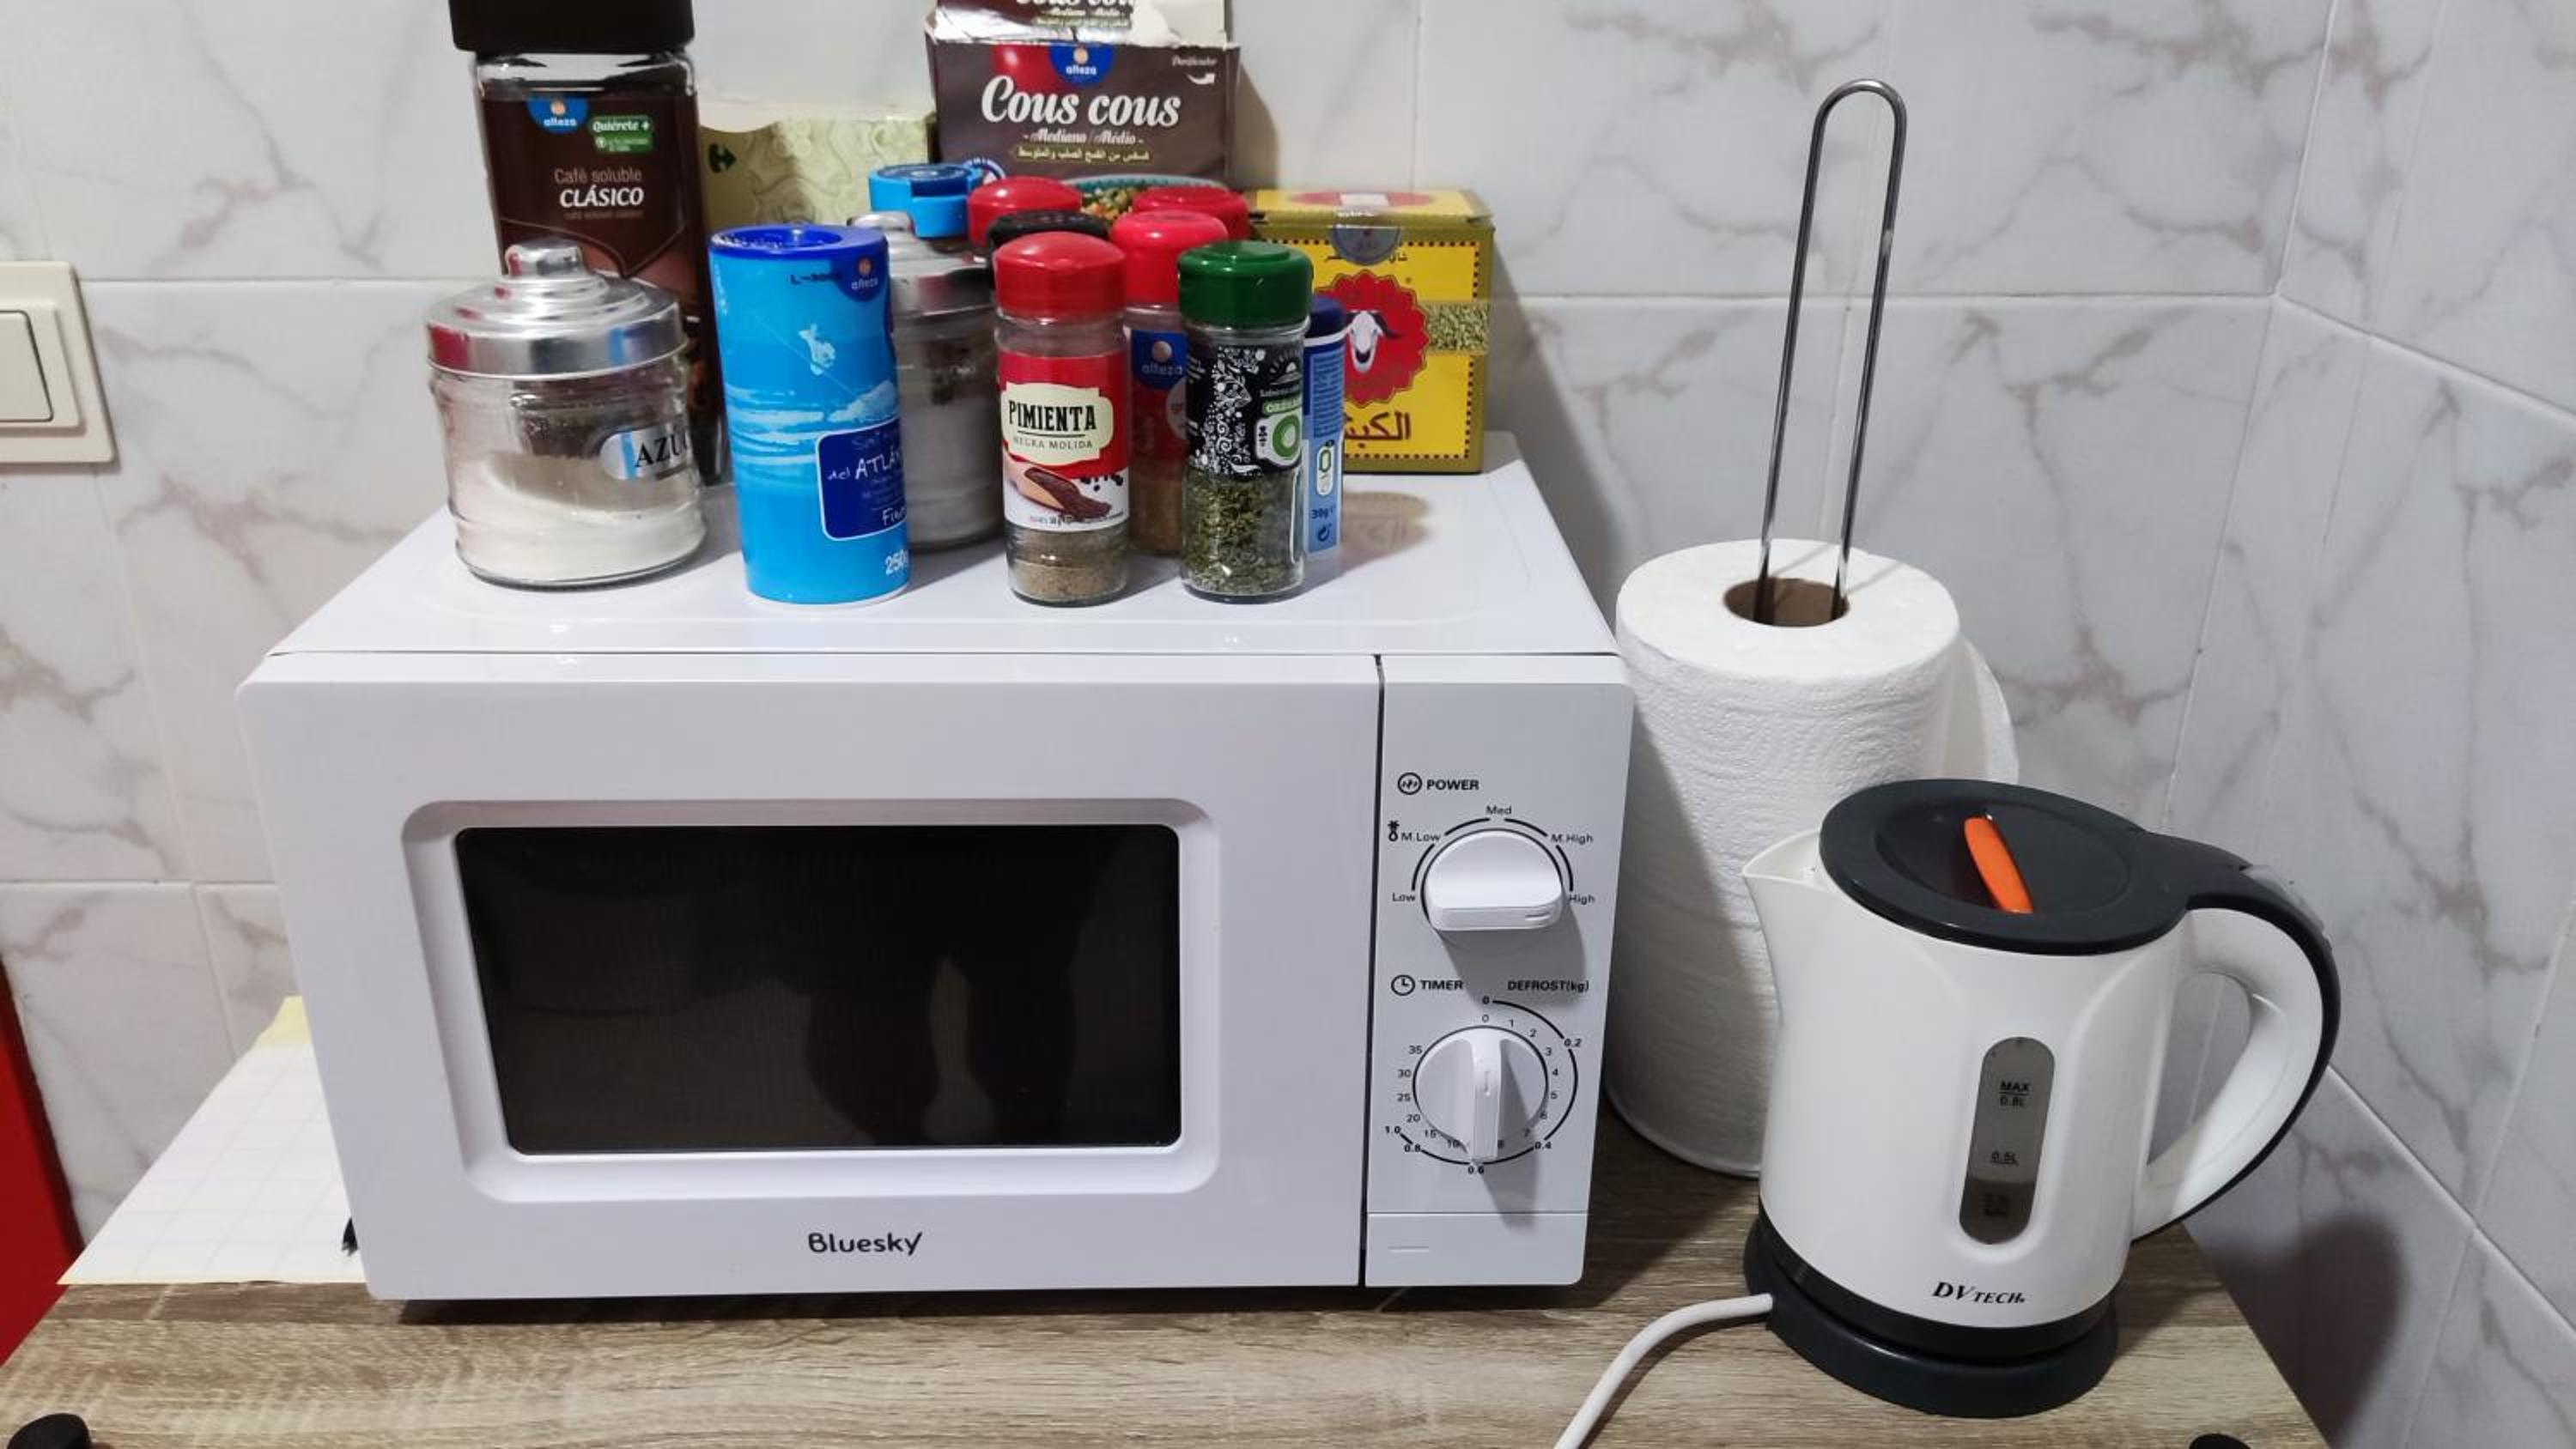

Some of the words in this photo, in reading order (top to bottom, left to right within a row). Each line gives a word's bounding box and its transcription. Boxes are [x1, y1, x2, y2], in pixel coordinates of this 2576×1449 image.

[1066, 65, 1097, 76] alteza
[981, 75, 1079, 125] Cous
[1088, 94, 1182, 128] cous
[554, 167, 587, 184] Café
[591, 166, 642, 183] soluble
[559, 185, 644, 208] CLÁSICO
[1008, 400, 1097, 431] PIMIENTA
[1048, 440, 1093, 450] MOLIDA
[1426, 779, 1479, 791] POWER
[1485, 805, 1512, 815] Med
[1392, 893, 1416, 902] Low
[1569, 894, 1596, 904] High
[1419, 980, 1464, 990] TIMER
[1482, 996, 1490, 1004] 0
[1509, 1019, 1515, 1028] 1
[1564, 1038, 1582, 1047] 0.2
[1409, 1046, 1423, 1054] 35
[1546, 1047, 1552, 1056] 3
[1398, 1069, 1412, 1078] 30
[1552, 1068, 1558, 1076] 4
[1999, 1081, 2032, 1091] MAX
[1397, 1093, 1412, 1101] 25
[1551, 1091, 1558, 1100] 5
[1406, 1113, 1421, 1123] 20
[1385, 1125, 1401, 1134] 1.0
[1425, 1129, 1437, 1138] 15
[1447, 1139, 1460, 1149] 10
[1534, 1141, 1552, 1149] 0.4
[1467, 1166, 1485, 1174] 0.6
[808, 1231, 923, 1256] Bluesky
